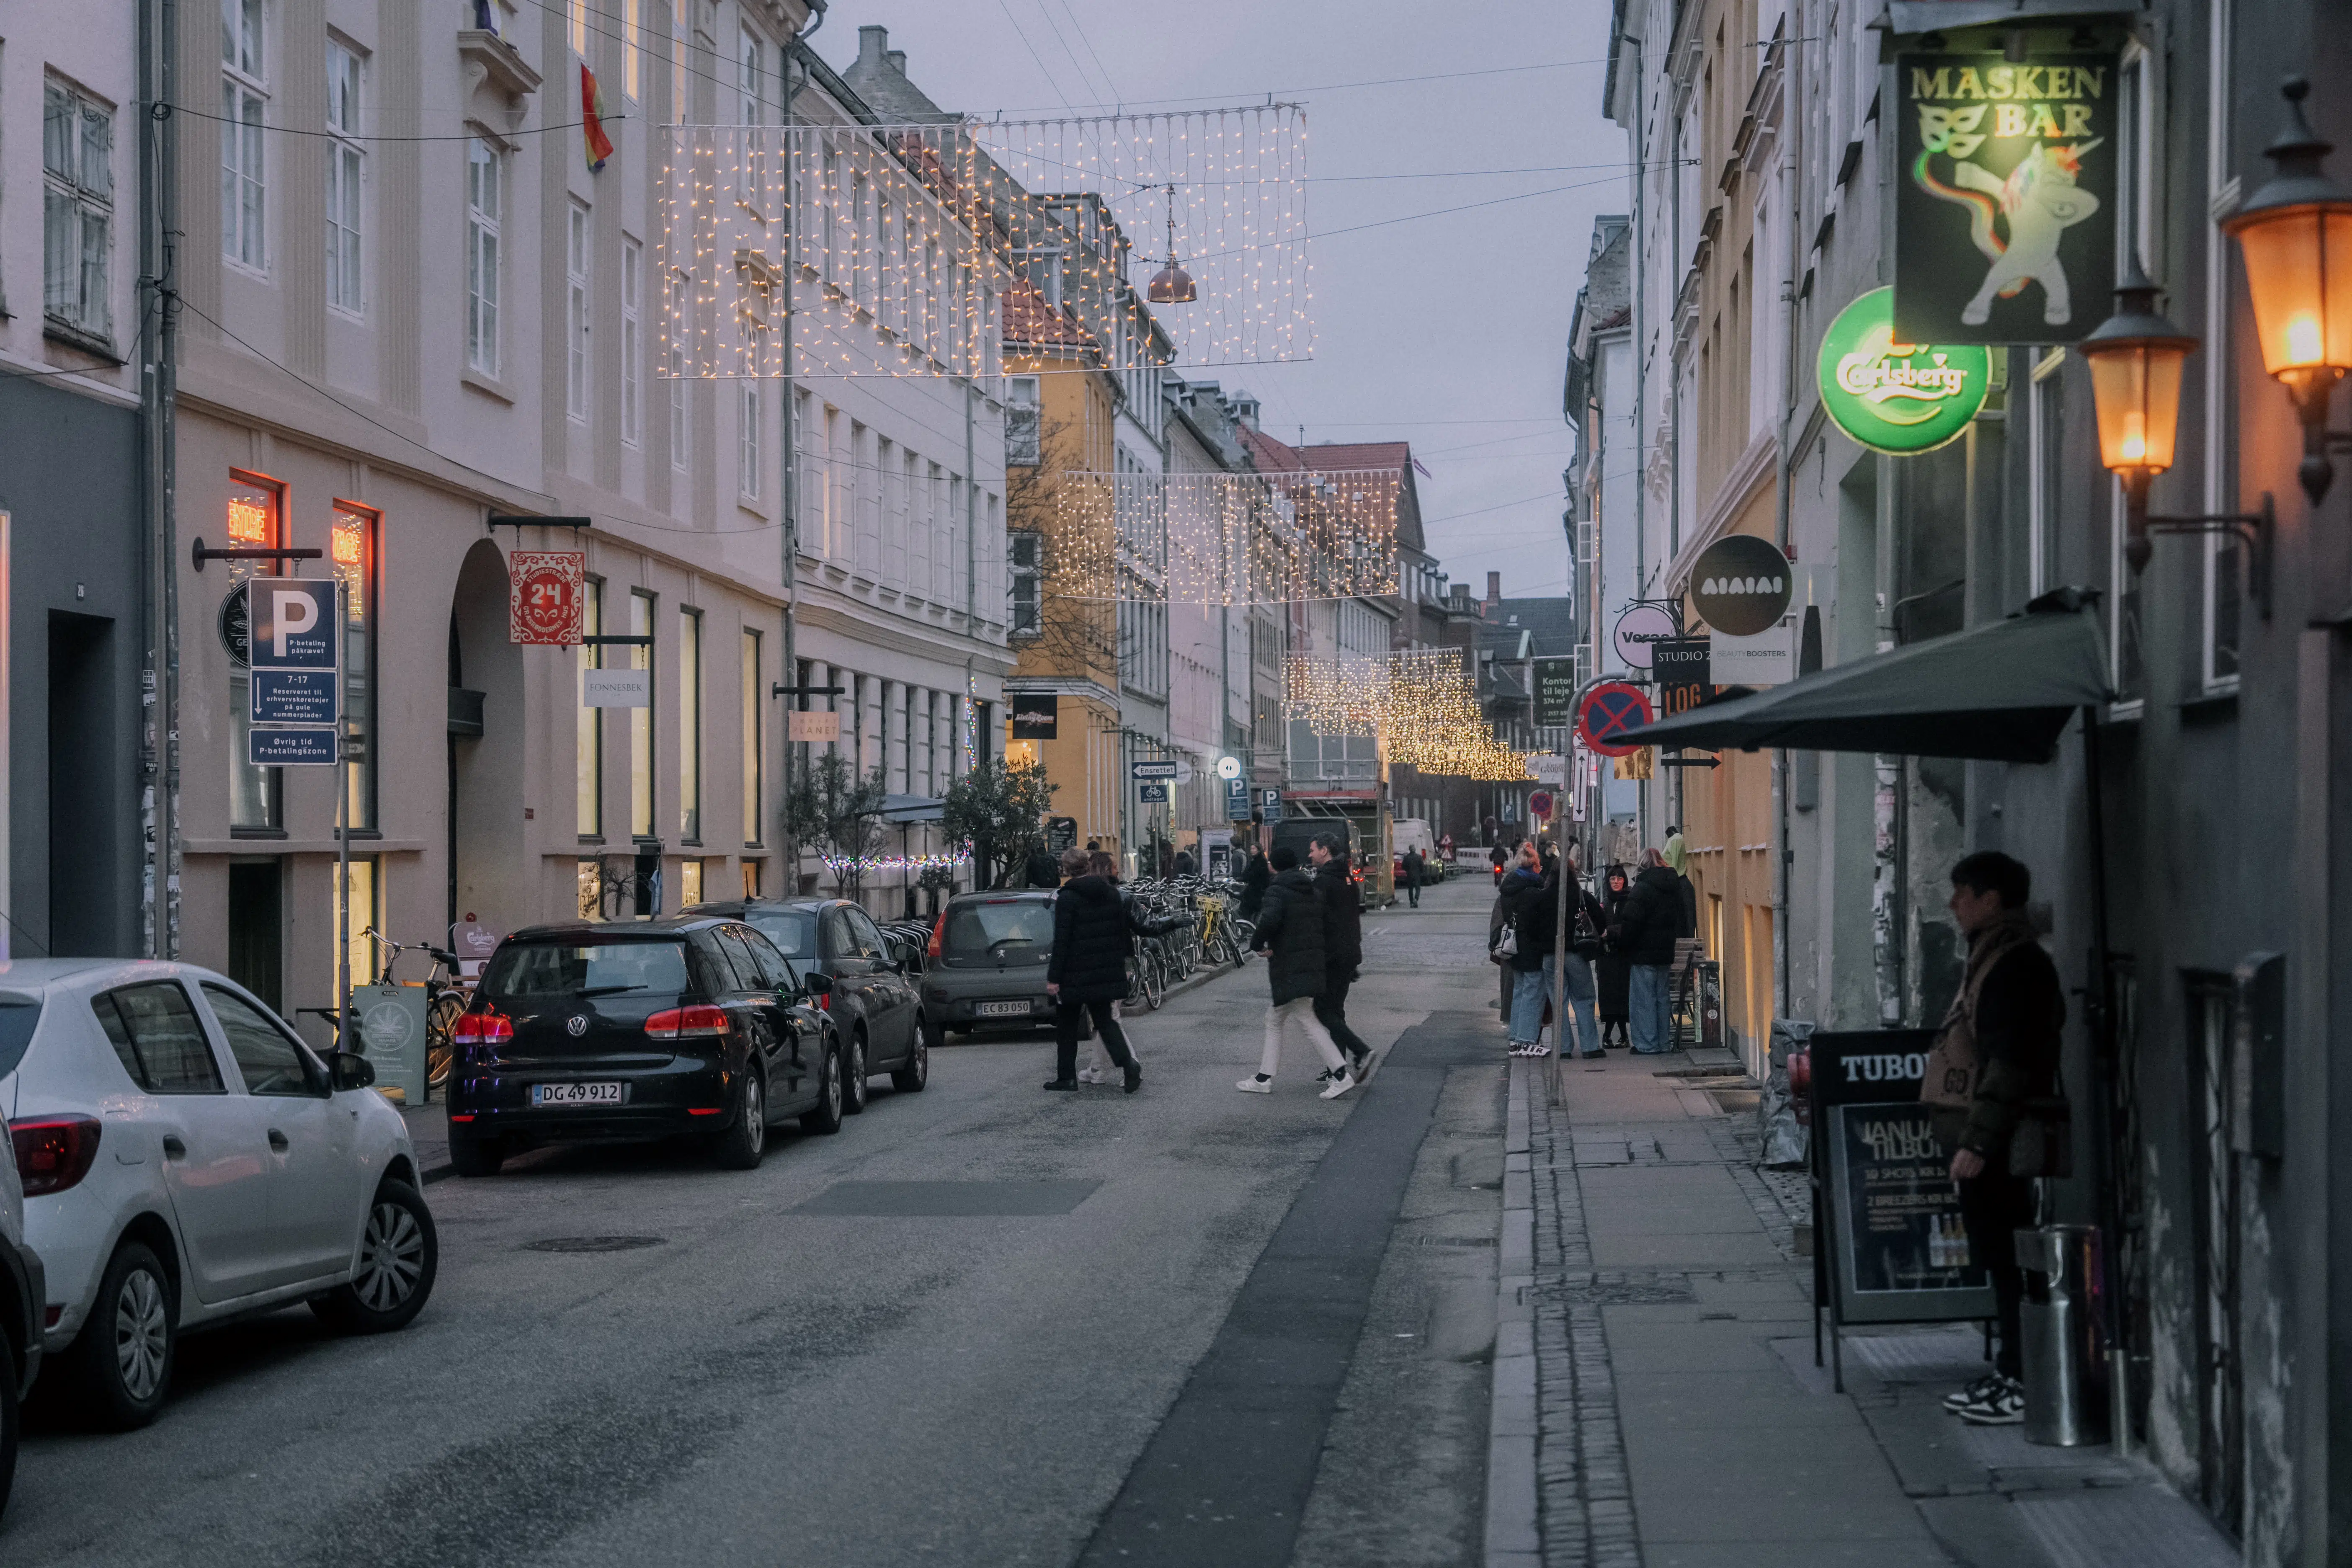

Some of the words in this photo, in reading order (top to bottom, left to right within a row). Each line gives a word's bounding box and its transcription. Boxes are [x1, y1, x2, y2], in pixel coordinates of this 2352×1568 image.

[1909, 65, 2107, 101] MASKEN
[1994, 103, 2093, 137] BAR
[1836, 352, 1967, 399] Carlsberg
[526, 568, 567, 583] STUDIESTRÆDE
[531, 583, 561, 605] 24
[273, 590, 318, 657] P
[1658, 651, 1702, 662] STUDIO
[1555, 686, 1569, 696] leje
[1232, 779, 1243, 796] P
[1266, 791, 1277, 805] P
[467, 932, 495, 944] Carlsberg
[984, 1004, 996, 1013] EC
[998, 1003, 1009, 1013] 83
[1011, 1003, 1029, 1012] 050
[1840, 1052, 1930, 1082] TUBO
[544, 1086, 564, 1100] DG
[567, 1086, 586, 1100] 49
[590, 1085, 618, 1100] 912
